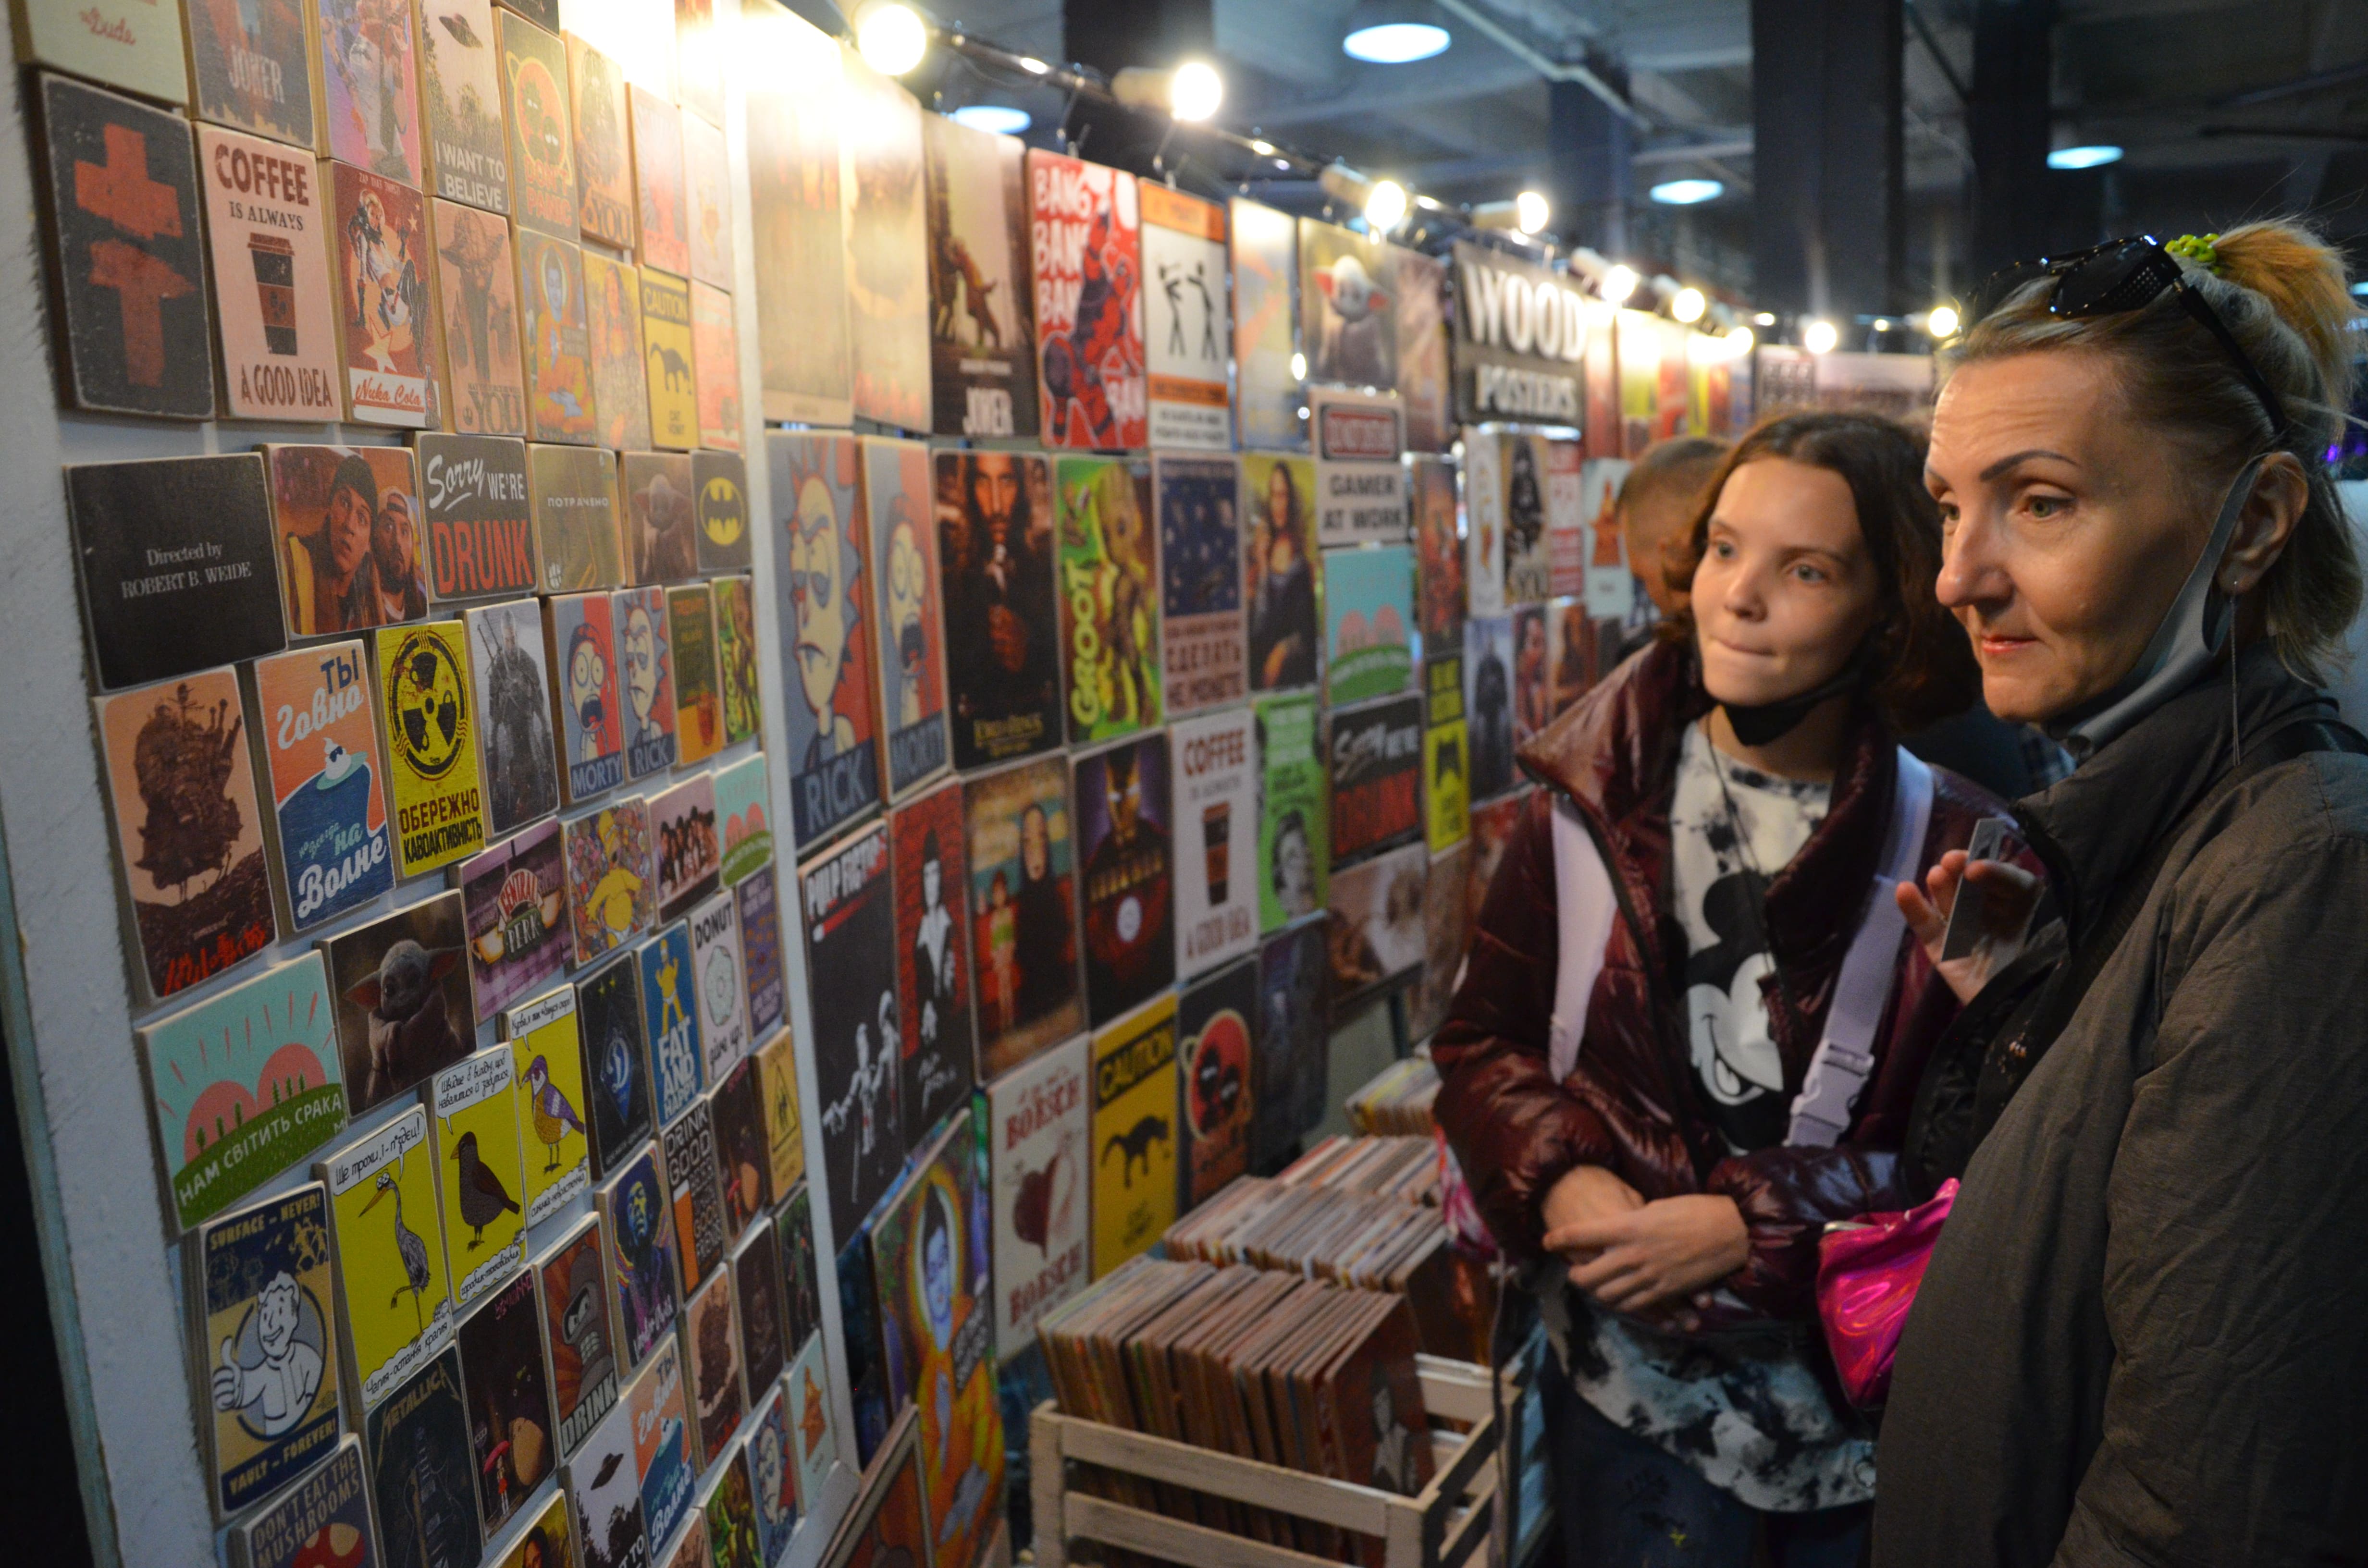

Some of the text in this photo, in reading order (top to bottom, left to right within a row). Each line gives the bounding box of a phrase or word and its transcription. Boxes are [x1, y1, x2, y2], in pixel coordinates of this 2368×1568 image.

[229, 44, 285, 104] JOKER
[215, 143, 310, 207] COFFEE
[435, 140, 505, 182] I WANT TO
[444, 173, 503, 210] BELIEVE
[526, 186, 572, 227] PANIC
[1033, 166, 1091, 217] BANG
[229, 201, 304, 232] IS ALWAYS
[643, 286, 688, 321] CAUTION
[1462, 262, 1585, 363] WOOD
[240, 364, 333, 408] A GOOD IDEA
[355, 377, 421, 405] Nuka Cola
[468, 390, 522, 433] YOU
[427, 454, 525, 509] Sorry WE'RE
[547, 496, 609, 509] ПОТРАЧЕНО
[146, 542, 222, 567] Directed by
[432, 519, 534, 594] DRUNK
[121, 561, 252, 600] ROBERT B. WEIDE
[1065, 558, 1100, 725] GROOT
[321, 649, 360, 694] ТЫ
[571, 756, 622, 795] MORTY
[633, 739, 668, 775] RICK
[399, 787, 480, 835] ОБЕРЕЖНО
[804, 747, 866, 833] RICK
[334, 822, 363, 856] на
[403, 817, 482, 864] КАВОАКТИВНІСТЬ
[297, 835, 387, 919] Волне
[499, 870, 538, 915] CENTRAL
[507, 914, 540, 954] PERK
[695, 902, 734, 950] DONUT
[657, 1016, 691, 1074] FAT
[663, 1052, 696, 1104] AND
[179, 1092, 342, 1207] НАМ СВІТИТЬ СРАКА
[665, 1102, 709, 1158] DRINK
[336, 1165, 349, 1186] Ще
[351, 1150, 382, 1180] трохи,
[667, 1130, 711, 1187] GOOD
[210, 1212, 266, 1252] SURFACE
[280, 1192, 321, 1222] NEVER!
[366, 1372, 389, 1395] Чапля
[393, 1345, 422, 1374] остання
[425, 1322, 448, 1352] крапля
[561, 1371, 617, 1456] DRINK
[229, 1459, 268, 1496] VAULT
[283, 1416, 337, 1463] FOREVER!
[254, 1448, 357, 1550] DON'T EAT THE
[257, 1470, 360, 1568] MUSHROOMS
[629, 1534, 645, 1563] TO
